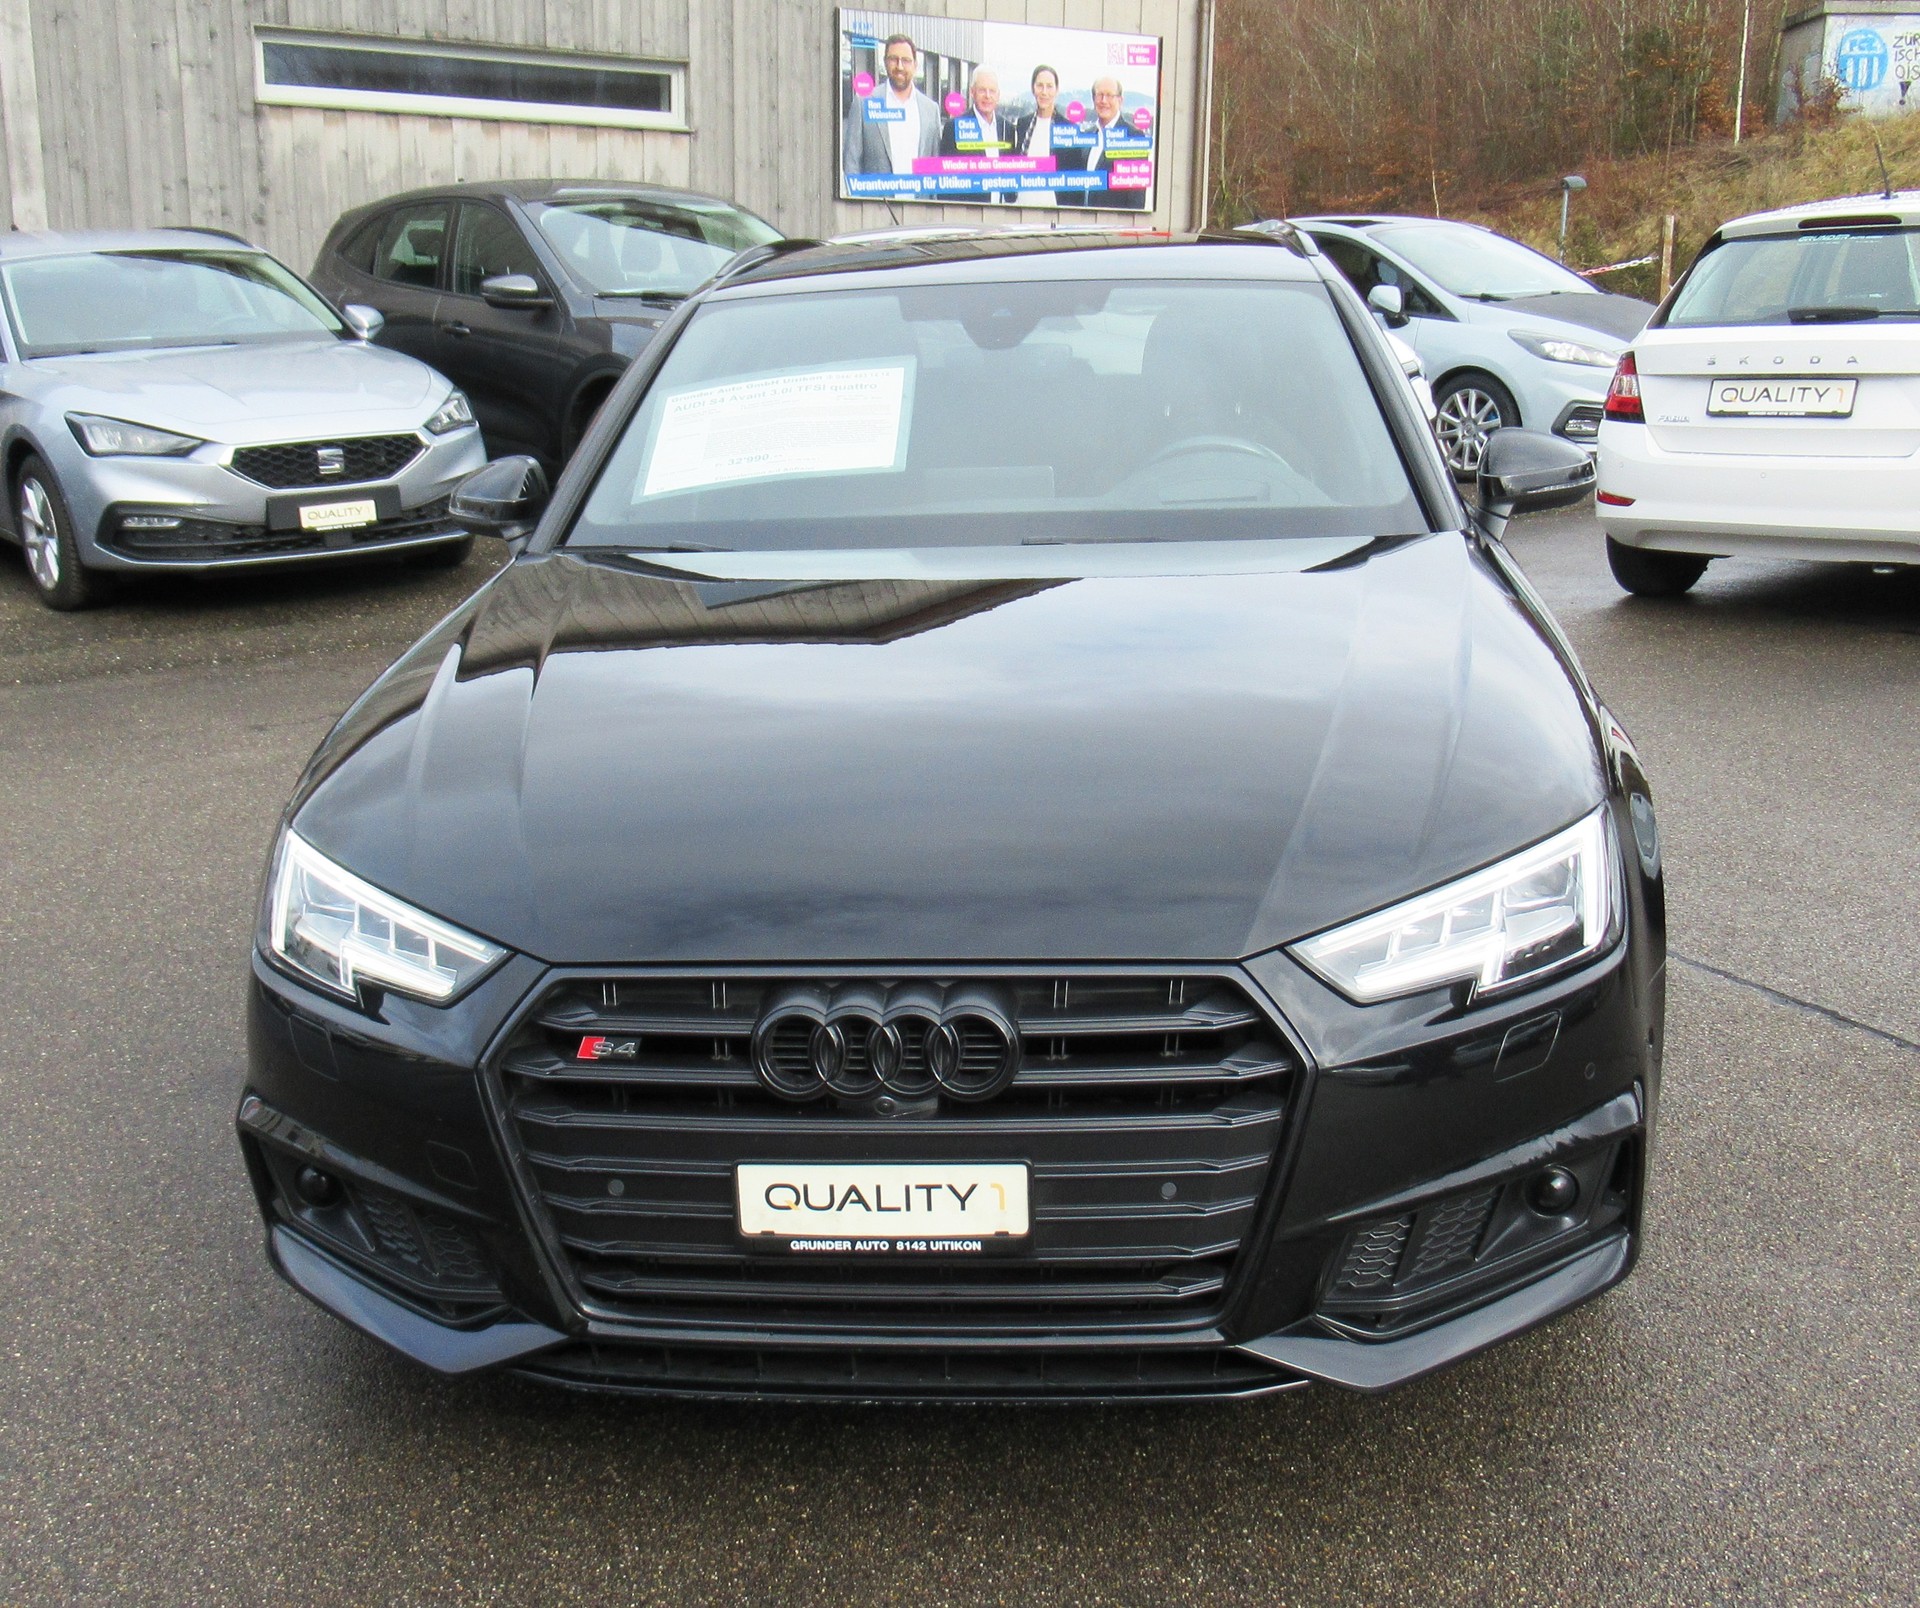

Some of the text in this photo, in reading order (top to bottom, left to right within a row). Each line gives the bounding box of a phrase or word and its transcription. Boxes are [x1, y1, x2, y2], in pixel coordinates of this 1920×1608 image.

[1105, 129, 1124, 138] Daniel
[942, 160, 1036, 170] Wieder in den Gemeinderat
[1116, 163, 1149, 173] Neu in die
[849, 177, 921, 192] Verantwortung
[923, 176, 937, 189] für
[939, 176, 971, 189] Uitikon
[981, 176, 1019, 190] gestern,
[1021, 175, 1046, 187] heute
[1048, 174, 1065, 187] und
[1067, 176, 1103, 189] morgen.
[1111, 175, 1150, 187] Schulpflege
[717, 385, 743, 394] Auto
[745, 379, 779, 389] GmbH
[674, 401, 706, 413] AUDI
[709, 397, 725, 406] S4
[729, 391, 767, 402] Avant
[797, 383, 826, 393] TFSI
[830, 382, 878, 392] quattro
[1720, 387, 1845, 403] QUALITY 1
[307, 506, 364, 521] QUALITY
[590, 1041, 636, 1058] S4
[764, 1183, 1006, 1212] QUALITY 1
[790, 1240, 982, 1251] GRUNDER AUTO 8142 UITIKON
